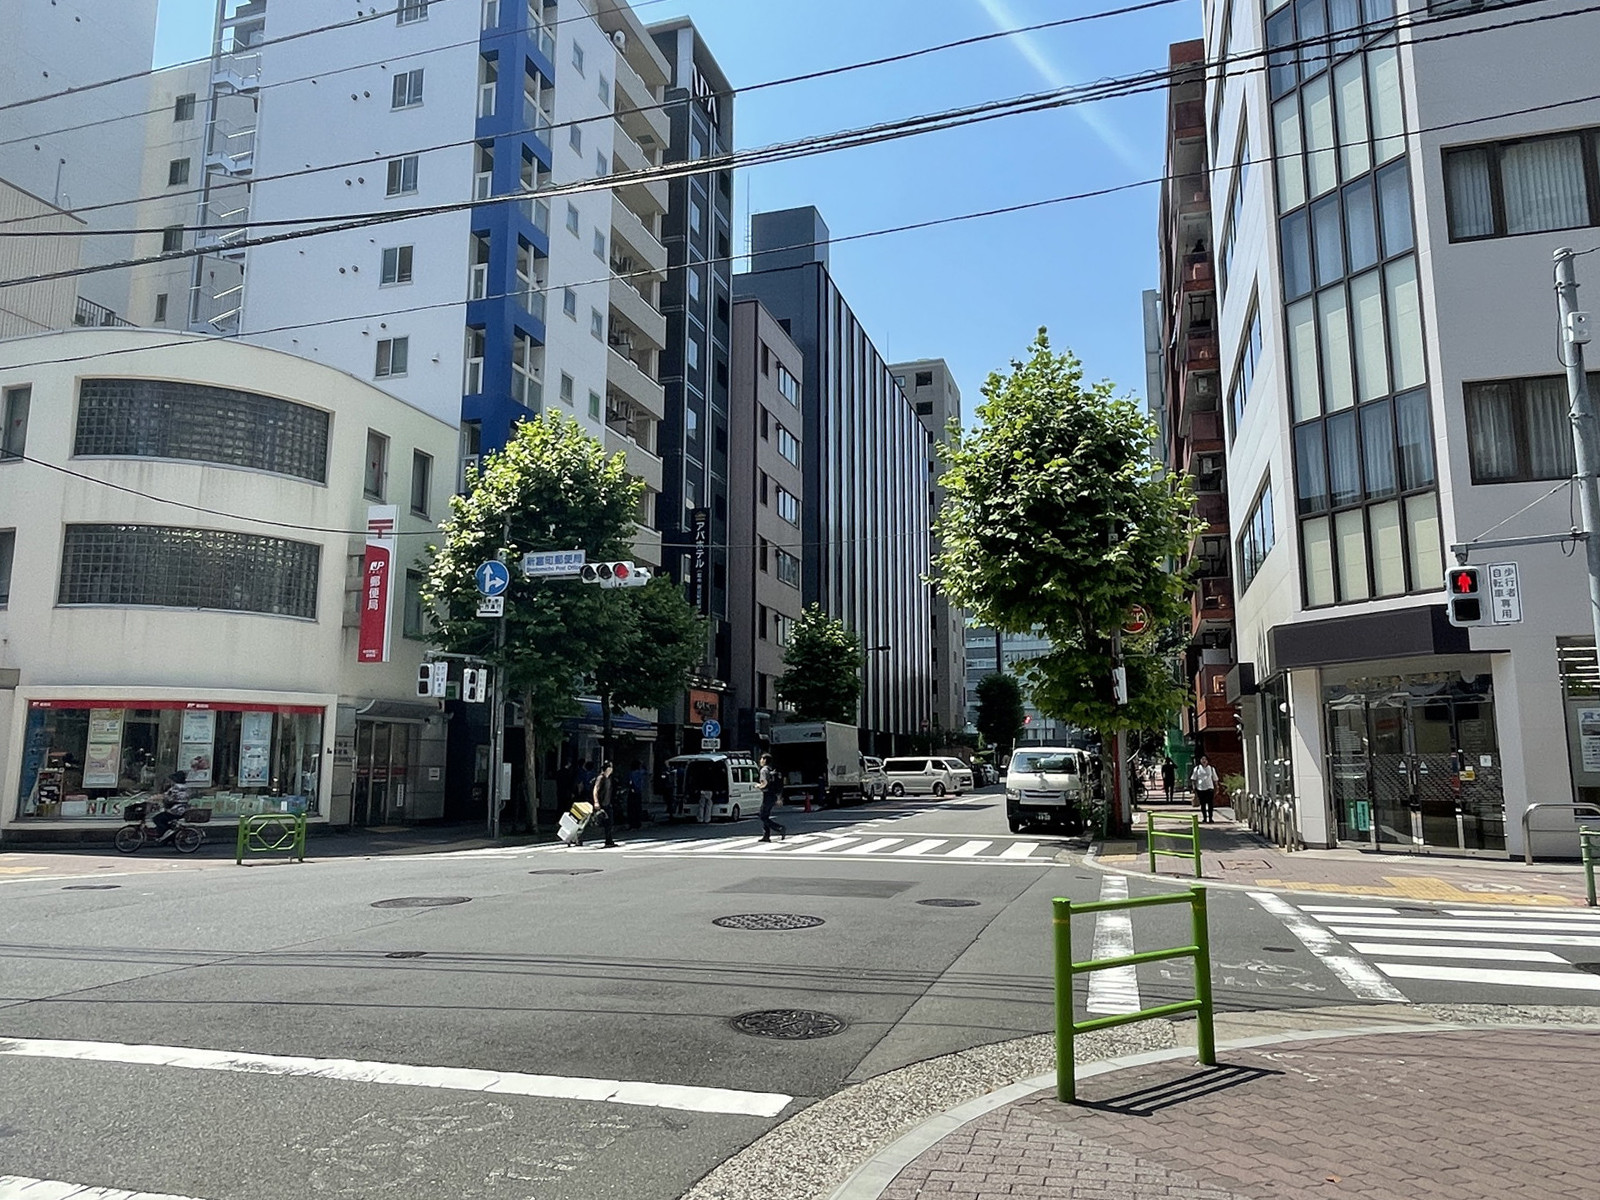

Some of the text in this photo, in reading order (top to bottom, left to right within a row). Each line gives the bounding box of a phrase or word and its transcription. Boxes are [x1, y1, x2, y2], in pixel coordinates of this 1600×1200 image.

[695, 521, 706, 568] アパホテル
[367, 575, 381, 611] 郵便局
[1492, 568, 1504, 598] 自転車
[1504, 567, 1516, 598] 歩行者
[1501, 598, 1512, 619] 専用
